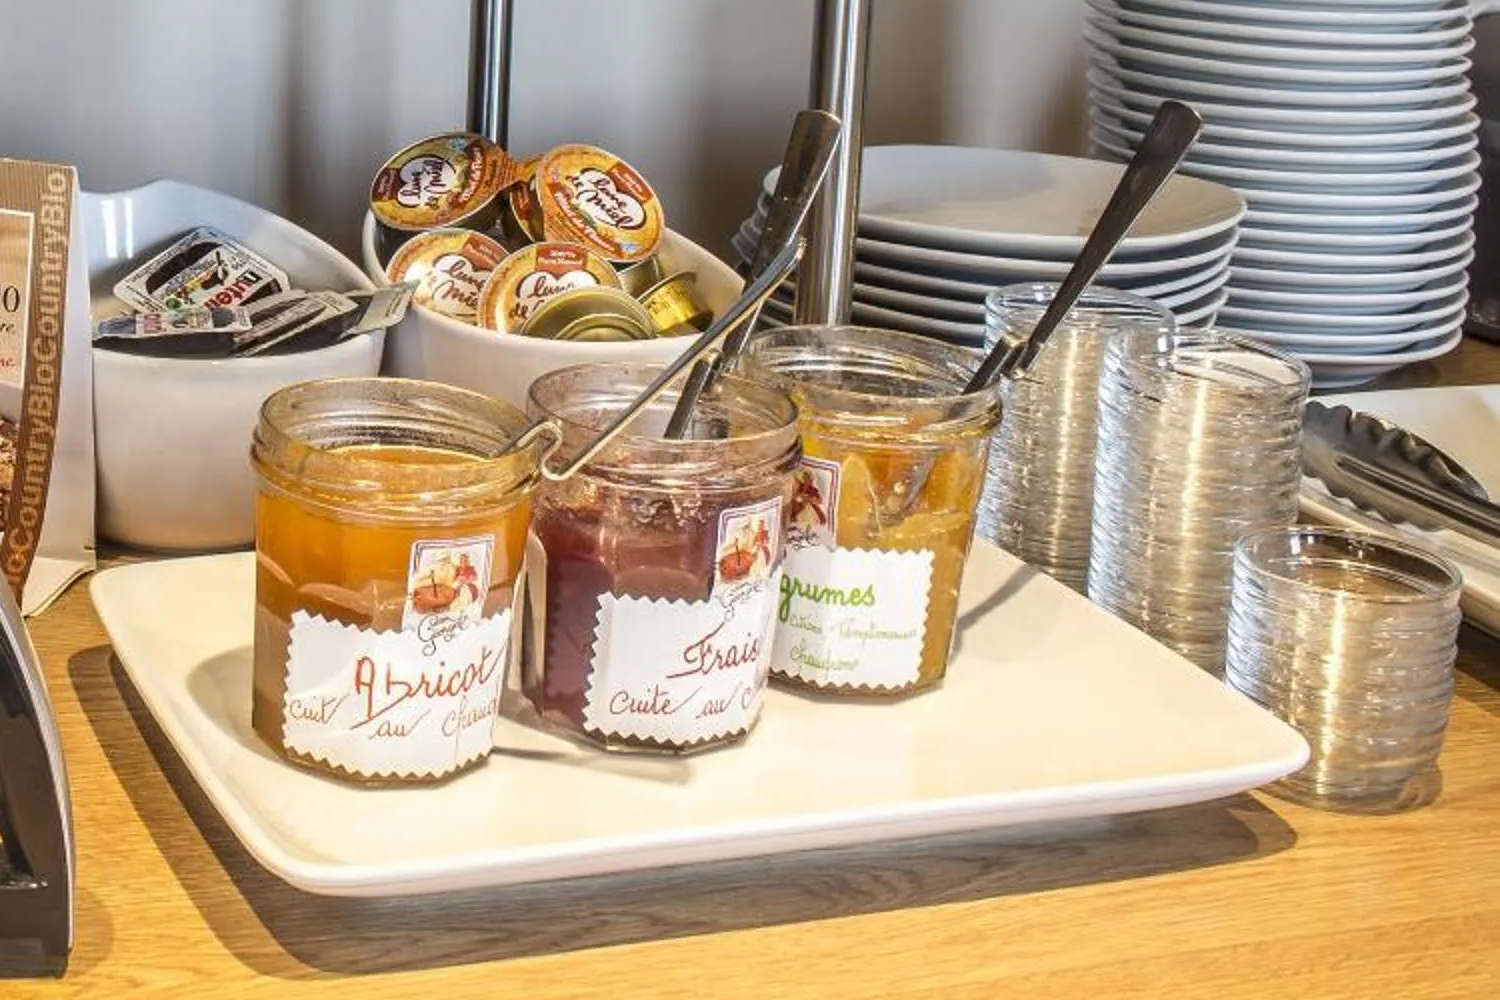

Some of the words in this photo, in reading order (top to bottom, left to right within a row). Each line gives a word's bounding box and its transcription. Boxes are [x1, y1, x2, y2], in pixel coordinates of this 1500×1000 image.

[778, 574, 876, 623] grumes
[351, 645, 506, 729] Abricot
[609, 684, 698, 715] Cuite
[290, 694, 347, 724] Cuit
